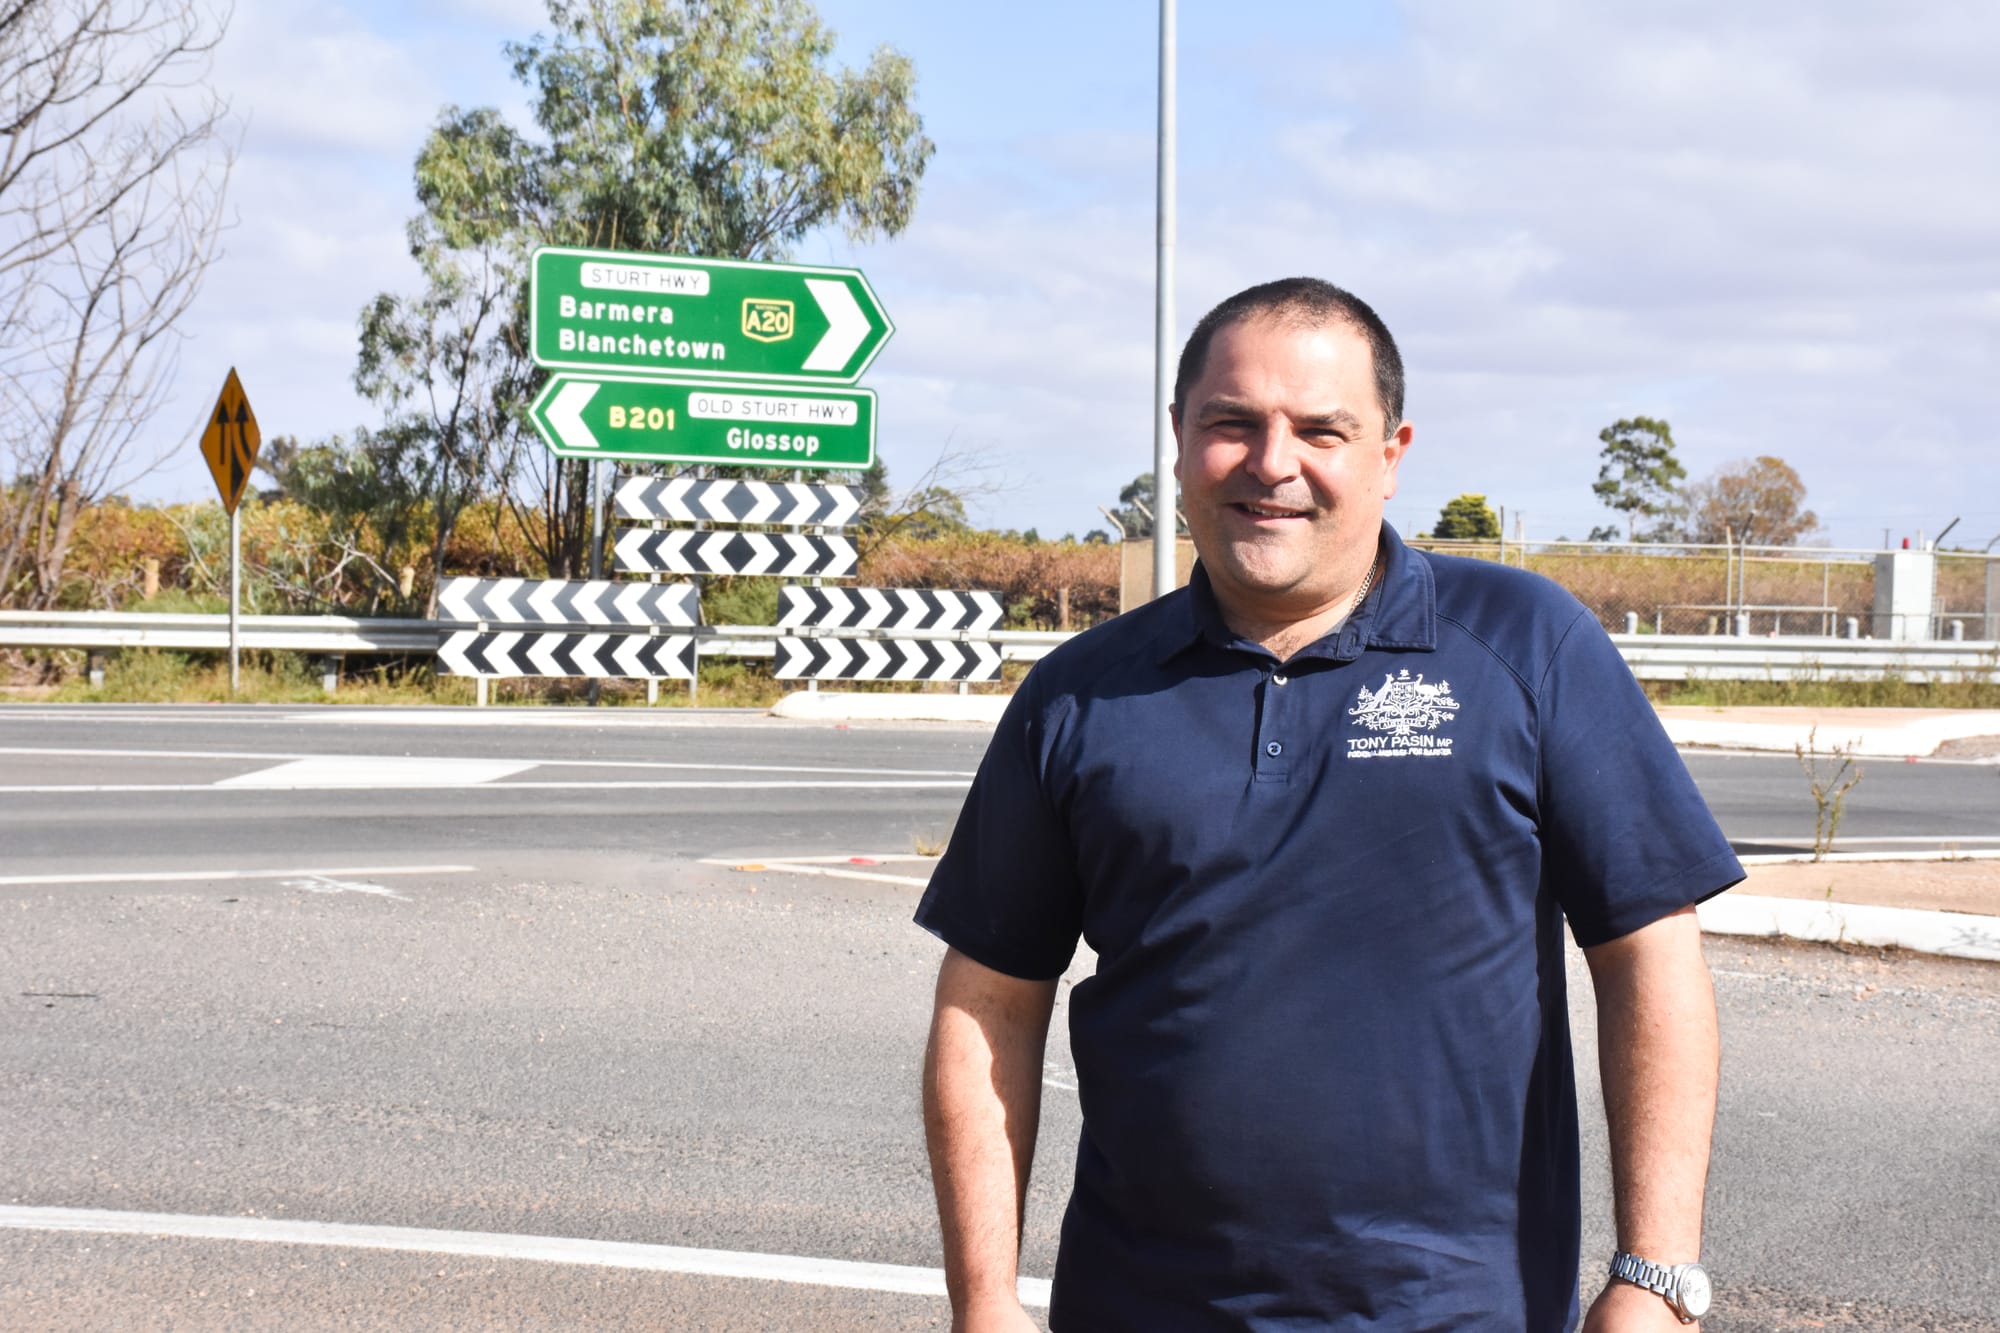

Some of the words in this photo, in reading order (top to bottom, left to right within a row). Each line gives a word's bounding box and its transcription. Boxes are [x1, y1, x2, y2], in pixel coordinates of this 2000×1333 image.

[591, 267, 651, 287] STURT
[660, 273, 701, 290] HWY
[559, 294, 674, 325] Barmera
[746, 309, 790, 333] A20
[559, 328, 726, 361] Blanchetown
[609, 405, 675, 431] B201
[697, 398, 733, 414] OLD
[741, 400, 799, 417] STURT
[808, 404, 849, 420] HWY
[726, 427, 820, 457] Glossop
[1347, 736, 1389, 750] TONY
[1391, 734, 1434, 748] PASIN
[1436, 737, 1453, 748] MP
